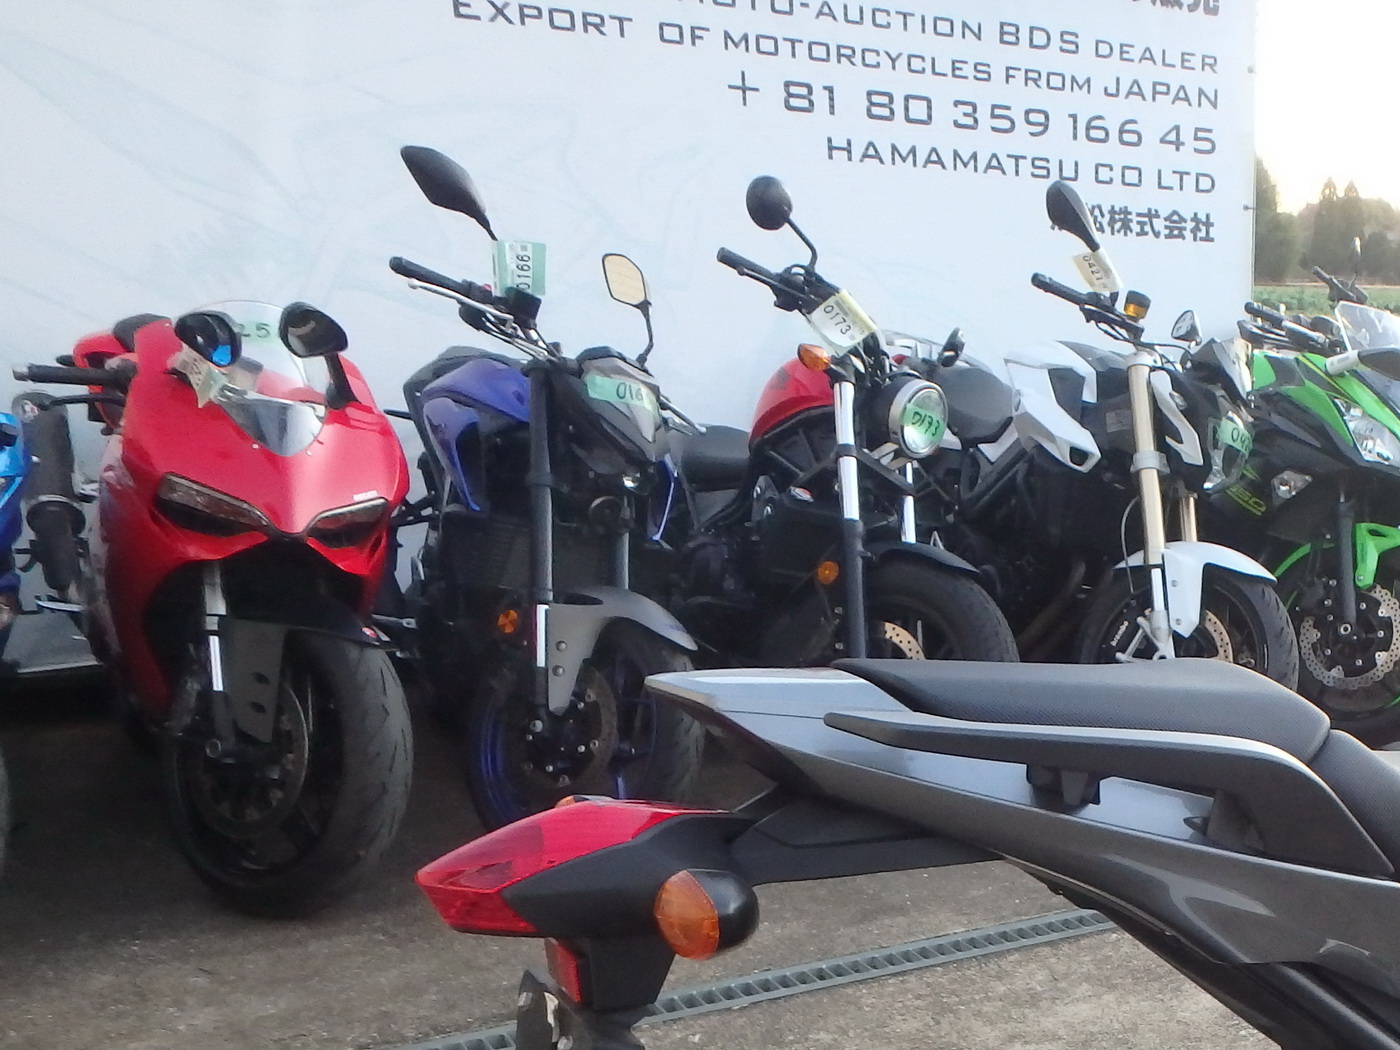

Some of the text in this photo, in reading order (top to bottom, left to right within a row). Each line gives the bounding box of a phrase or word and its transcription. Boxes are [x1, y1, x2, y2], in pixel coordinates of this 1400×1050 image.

[453, 0, 1219, 110] EXPORT OF MOTORCYCLES FROM JAPAN
[998, 21, 1080, 54] BDS
[1094, 40, 1219, 73] DEALER
[727, 70, 1217, 155] + 81 80 359 166 45
[826, 136, 1216, 194] HAMAMATSU CO LTD
[823, 304, 852, 335] 0173
[911, 411, 941, 437] 0173
